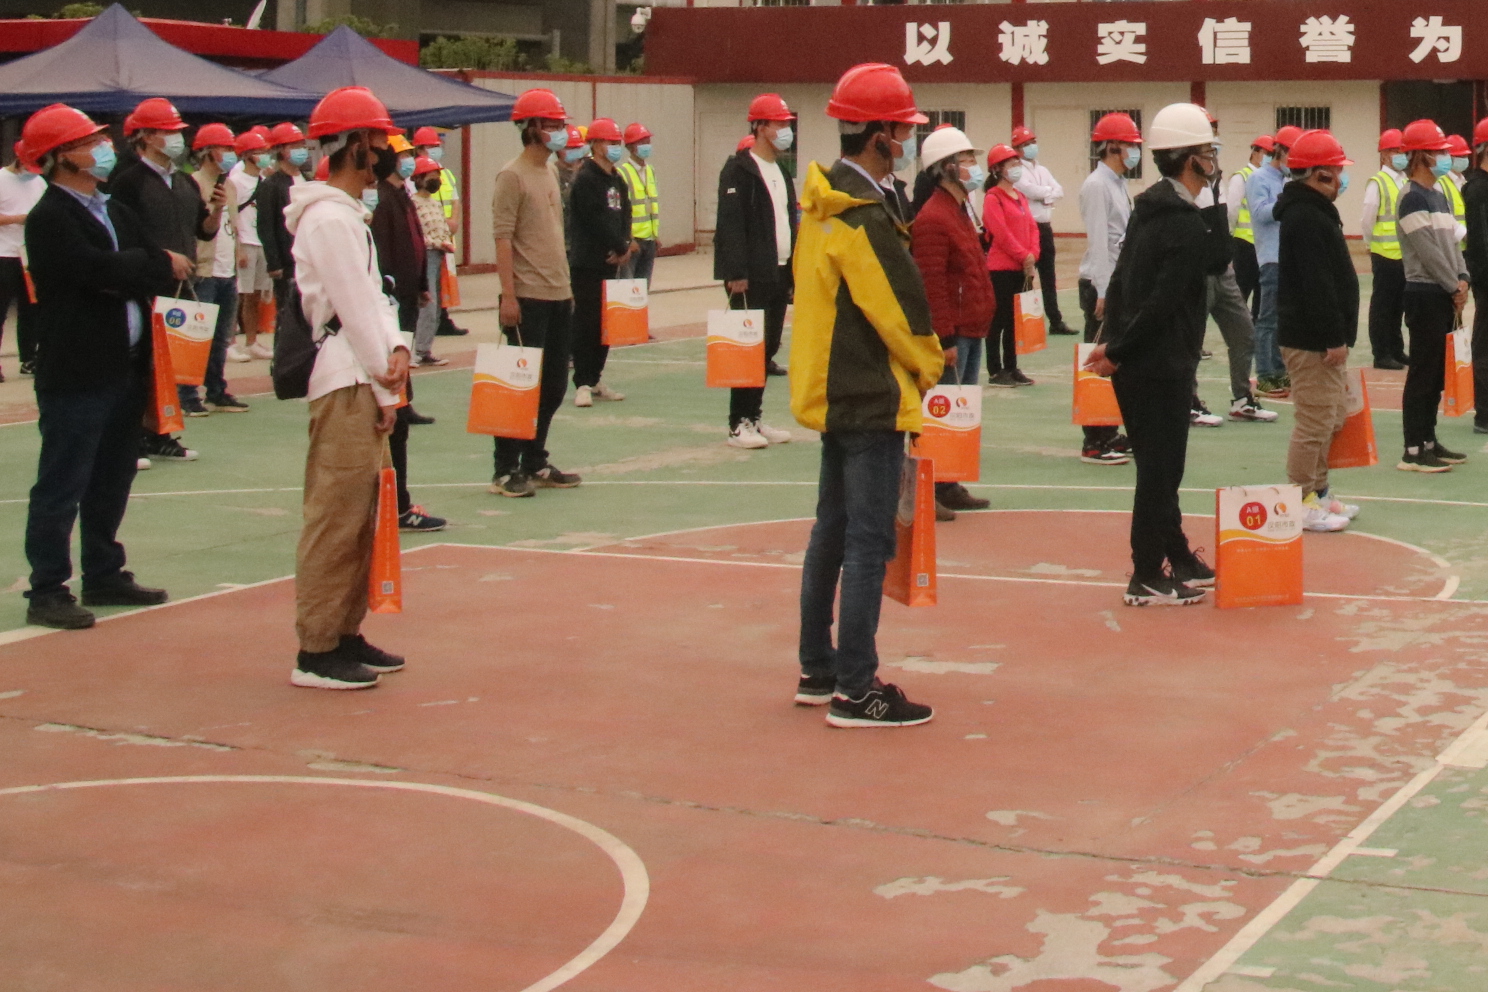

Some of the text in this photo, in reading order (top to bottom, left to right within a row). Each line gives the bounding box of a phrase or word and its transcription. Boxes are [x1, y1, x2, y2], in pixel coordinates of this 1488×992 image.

[932, 405, 946, 415] 02
[1246, 514, 1261, 527] 01
[864, 698, 889, 719] N
